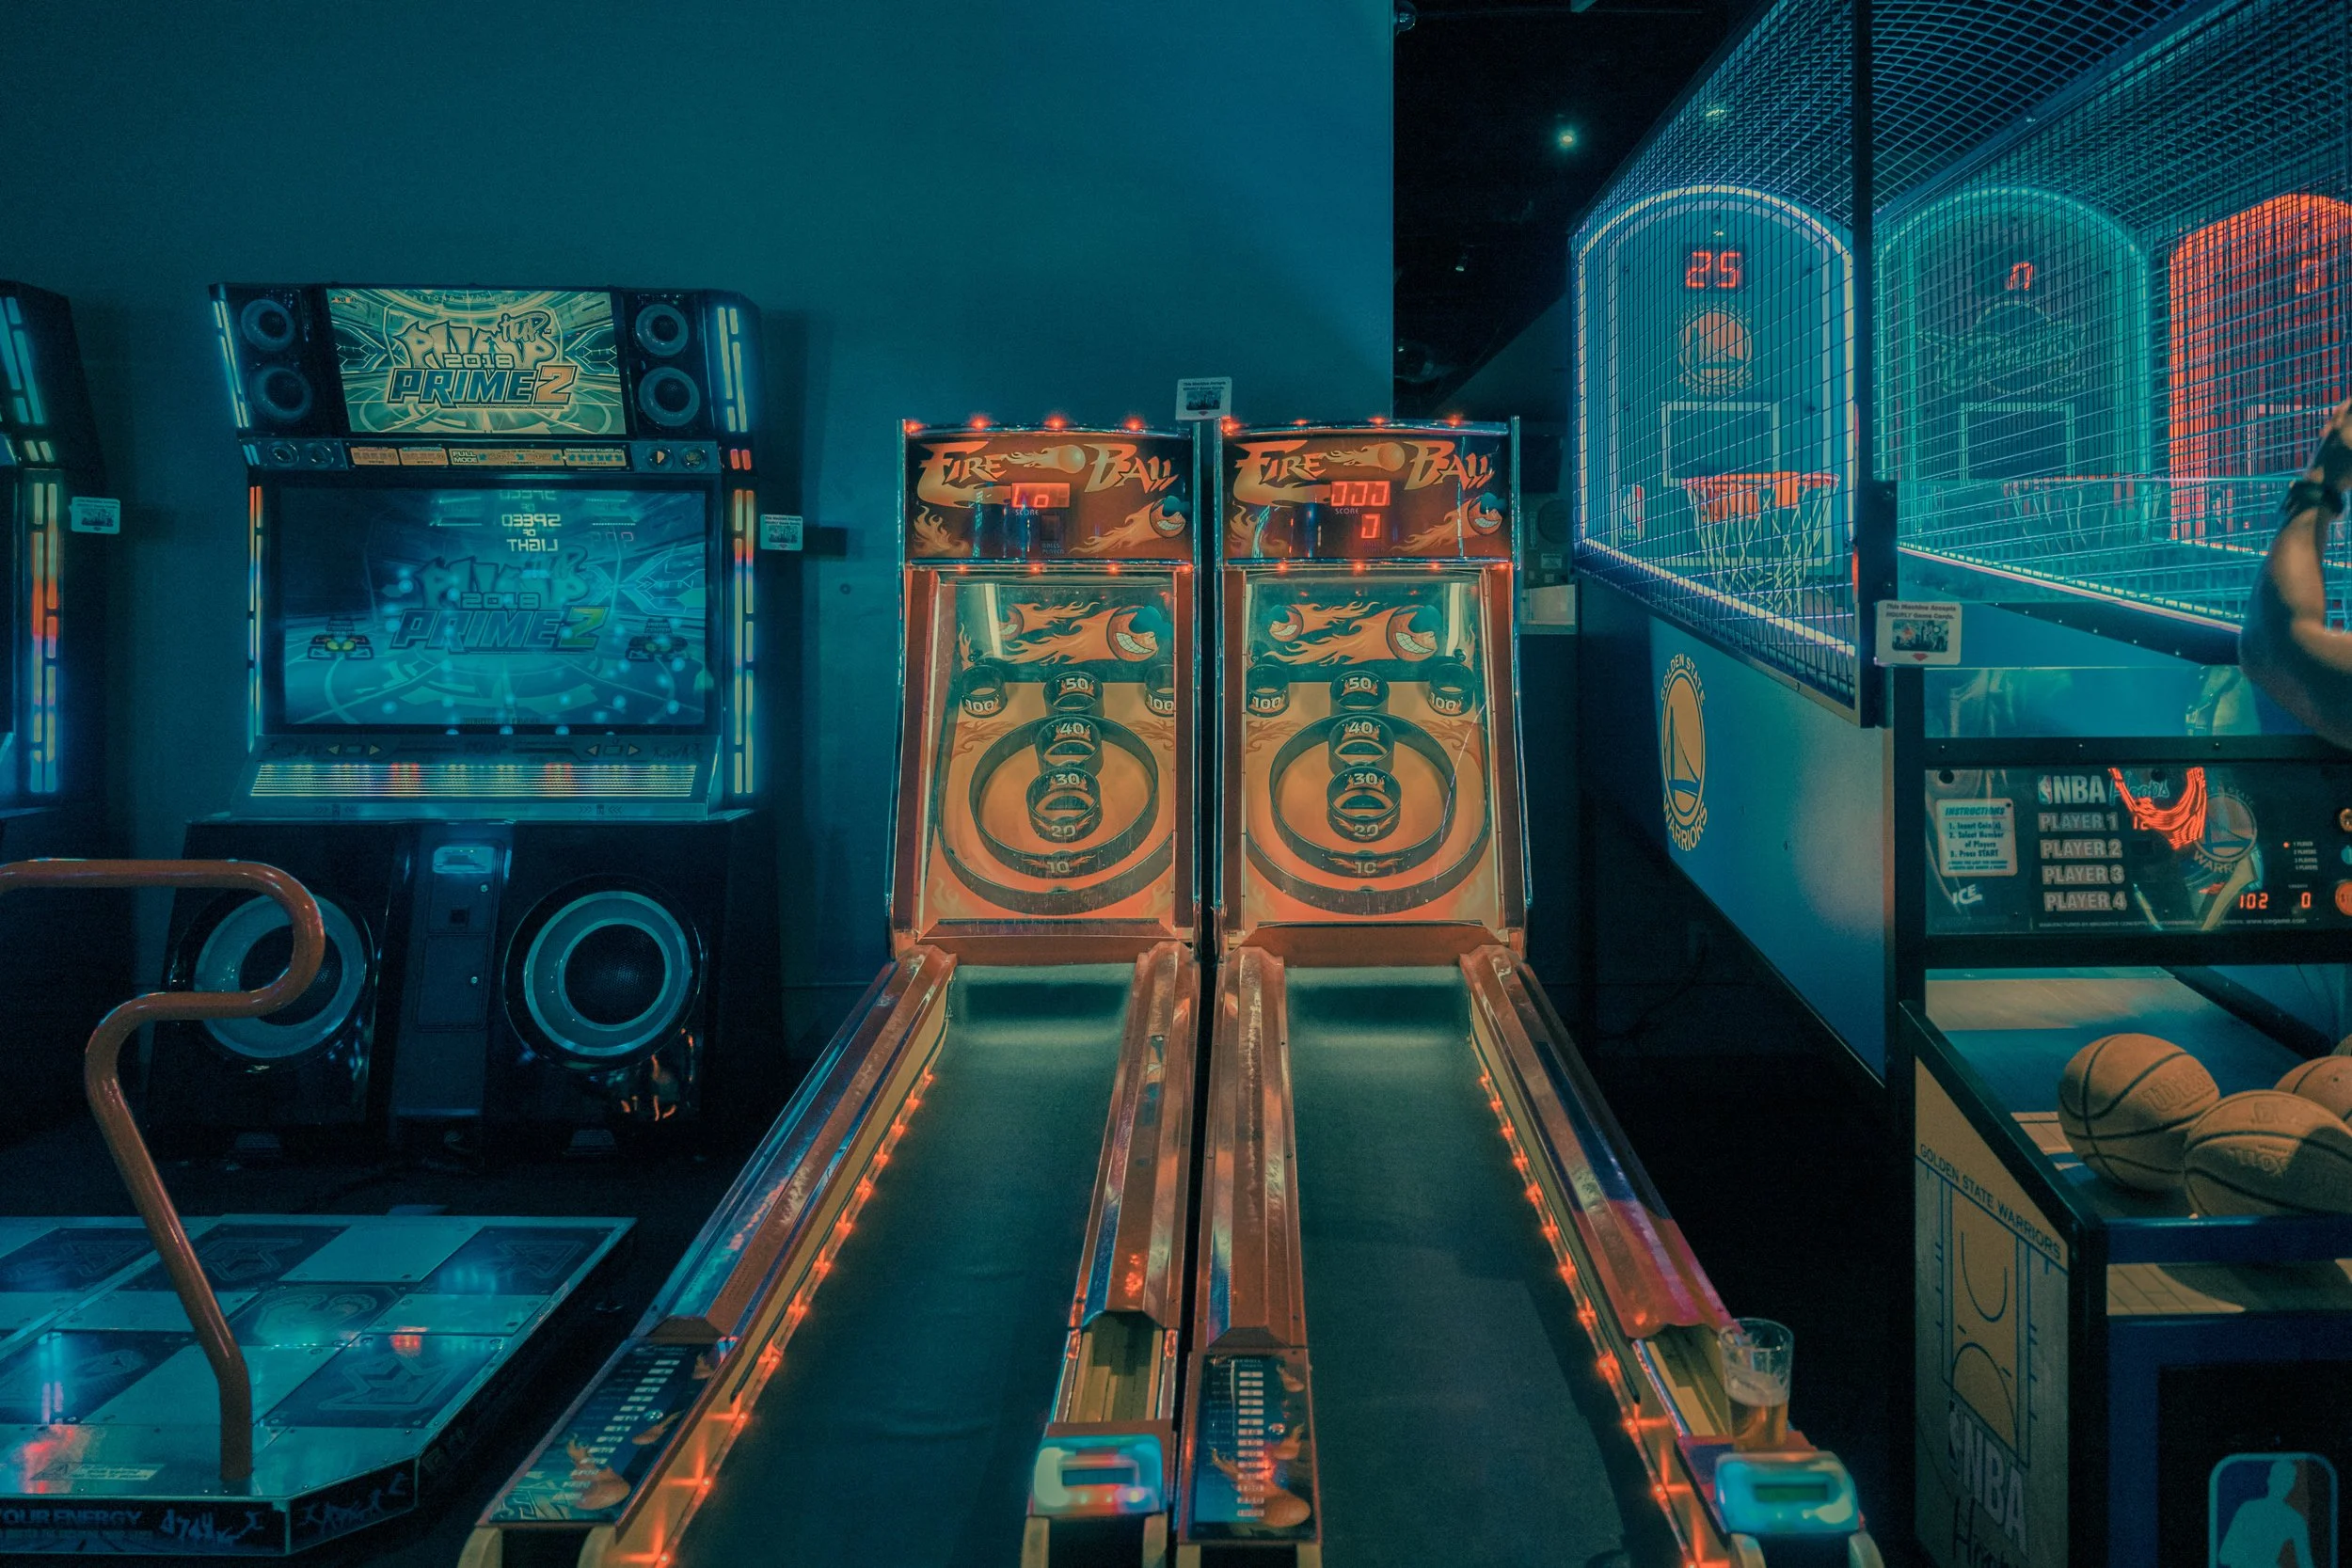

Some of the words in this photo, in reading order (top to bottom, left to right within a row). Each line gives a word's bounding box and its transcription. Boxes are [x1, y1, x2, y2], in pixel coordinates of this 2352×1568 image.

[1686, 250, 1740, 289] 25
[444, 354, 515, 369] 2018
[387, 368, 538, 408] PRIME
[917, 440, 1009, 507] FIRE
[1233, 439, 1327, 506] FIRE
[461, 592, 542, 610] 2018
[389, 609, 564, 654] PRIME
[1066, 677, 1089, 689] 50
[1349, 677, 1372, 689] 50
[1661, 653, 1685, 701] GOLDEN
[1686, 657, 1706, 706] STATE
[966, 699, 995, 712] 100
[1252, 696, 1280, 709] 100
[1430, 693, 1458, 710] 100
[1061, 721, 1084, 735] 40
[1349, 721, 1373, 734] 40
[1056, 773, 1080, 785] 30
[1354, 772, 1377, 784] 30
[2054, 775, 2106, 804] NBA
[1945, 806, 2005, 816] INSTRUCTIONS
[1663, 793, 1708, 852] WARRIORS
[2040, 813, 2106, 831] PLAYER
[2107, 812, 2119, 831] 1
[1051, 825, 1076, 837] 20
[1354, 825, 1379, 837] 20
[1973, 840, 1995, 849] Players
[1978, 848, 1998, 857] START
[2042, 840, 2106, 857] PLAYER
[2108, 839, 2122, 857] 2
[1047, 861, 1070, 874] 10
[1354, 861, 1377, 874] 10
[2043, 866, 2108, 883] PLAYER
[2110, 865, 2124, 883] 3
[1952, 883, 1982, 905] ICE
[2044, 893, 2111, 911] PLAYER
[2112, 892, 2126, 910] 4
[2238, 892, 2268, 910] 102
[2300, 892, 2312, 909] 0
[1920, 1143, 1960, 1183] GOLDEN
[1963, 1175, 1994, 1209] STATE
[1997, 1202, 2061, 1260] WARRIORS
[1963, 1416, 2027, 1559] NBA
[0, 1509, 50, 1524] OUR
[53, 1509, 143, 1524] ENERGY
